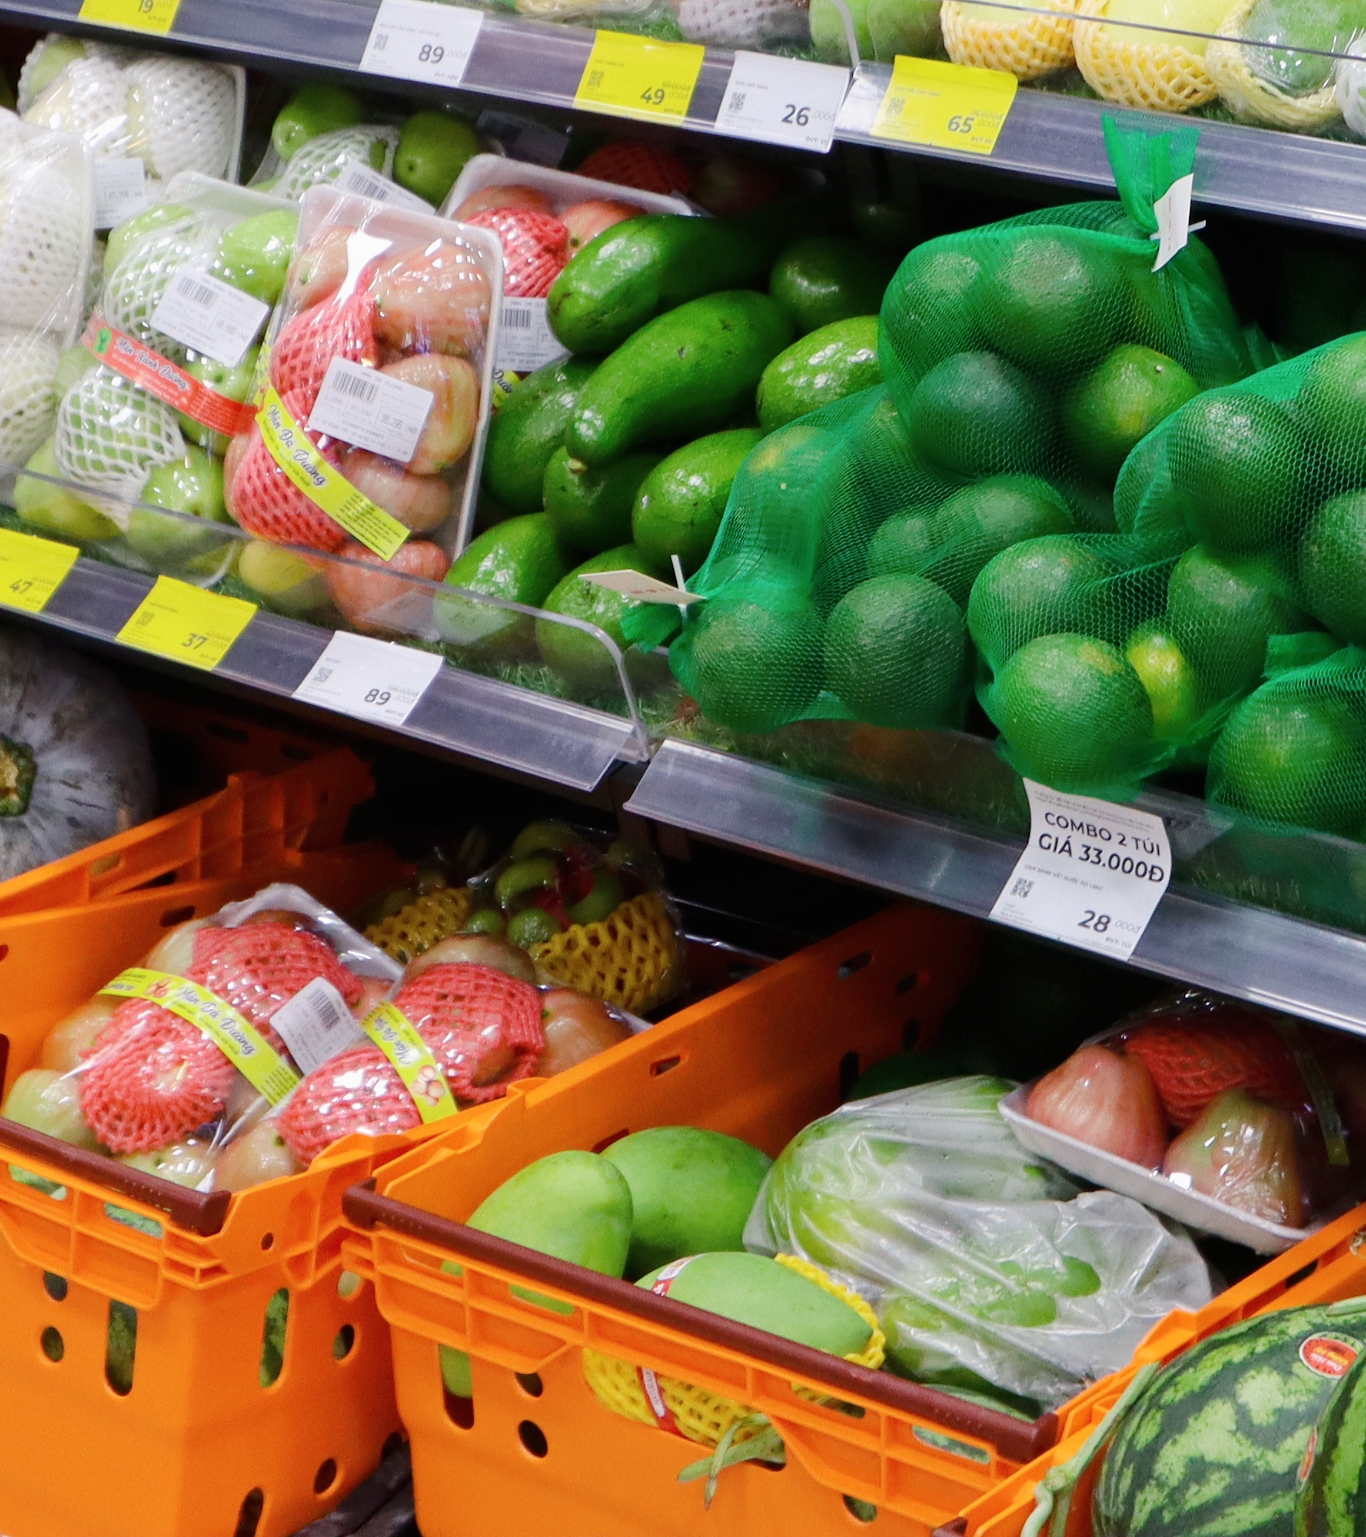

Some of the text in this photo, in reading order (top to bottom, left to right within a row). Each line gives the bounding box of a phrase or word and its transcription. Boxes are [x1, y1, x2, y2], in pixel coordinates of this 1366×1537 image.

[417, 42, 446, 64] 89
[640, 86, 665, 106] 49
[780, 104, 811, 128] 26
[947, 115, 976, 135] 65
[8, 577, 34, 595] 47
[181, 632, 209, 650] 37
[364, 688, 392, 706] 89
[1044, 812, 1113, 842] COMBO
[1117, 832, 1127, 847] 2
[1131, 836, 1162, 857] TÚI
[1038, 833, 1165, 884] GIÁ 33.000Đ
[1077, 910, 1112, 933] 28
